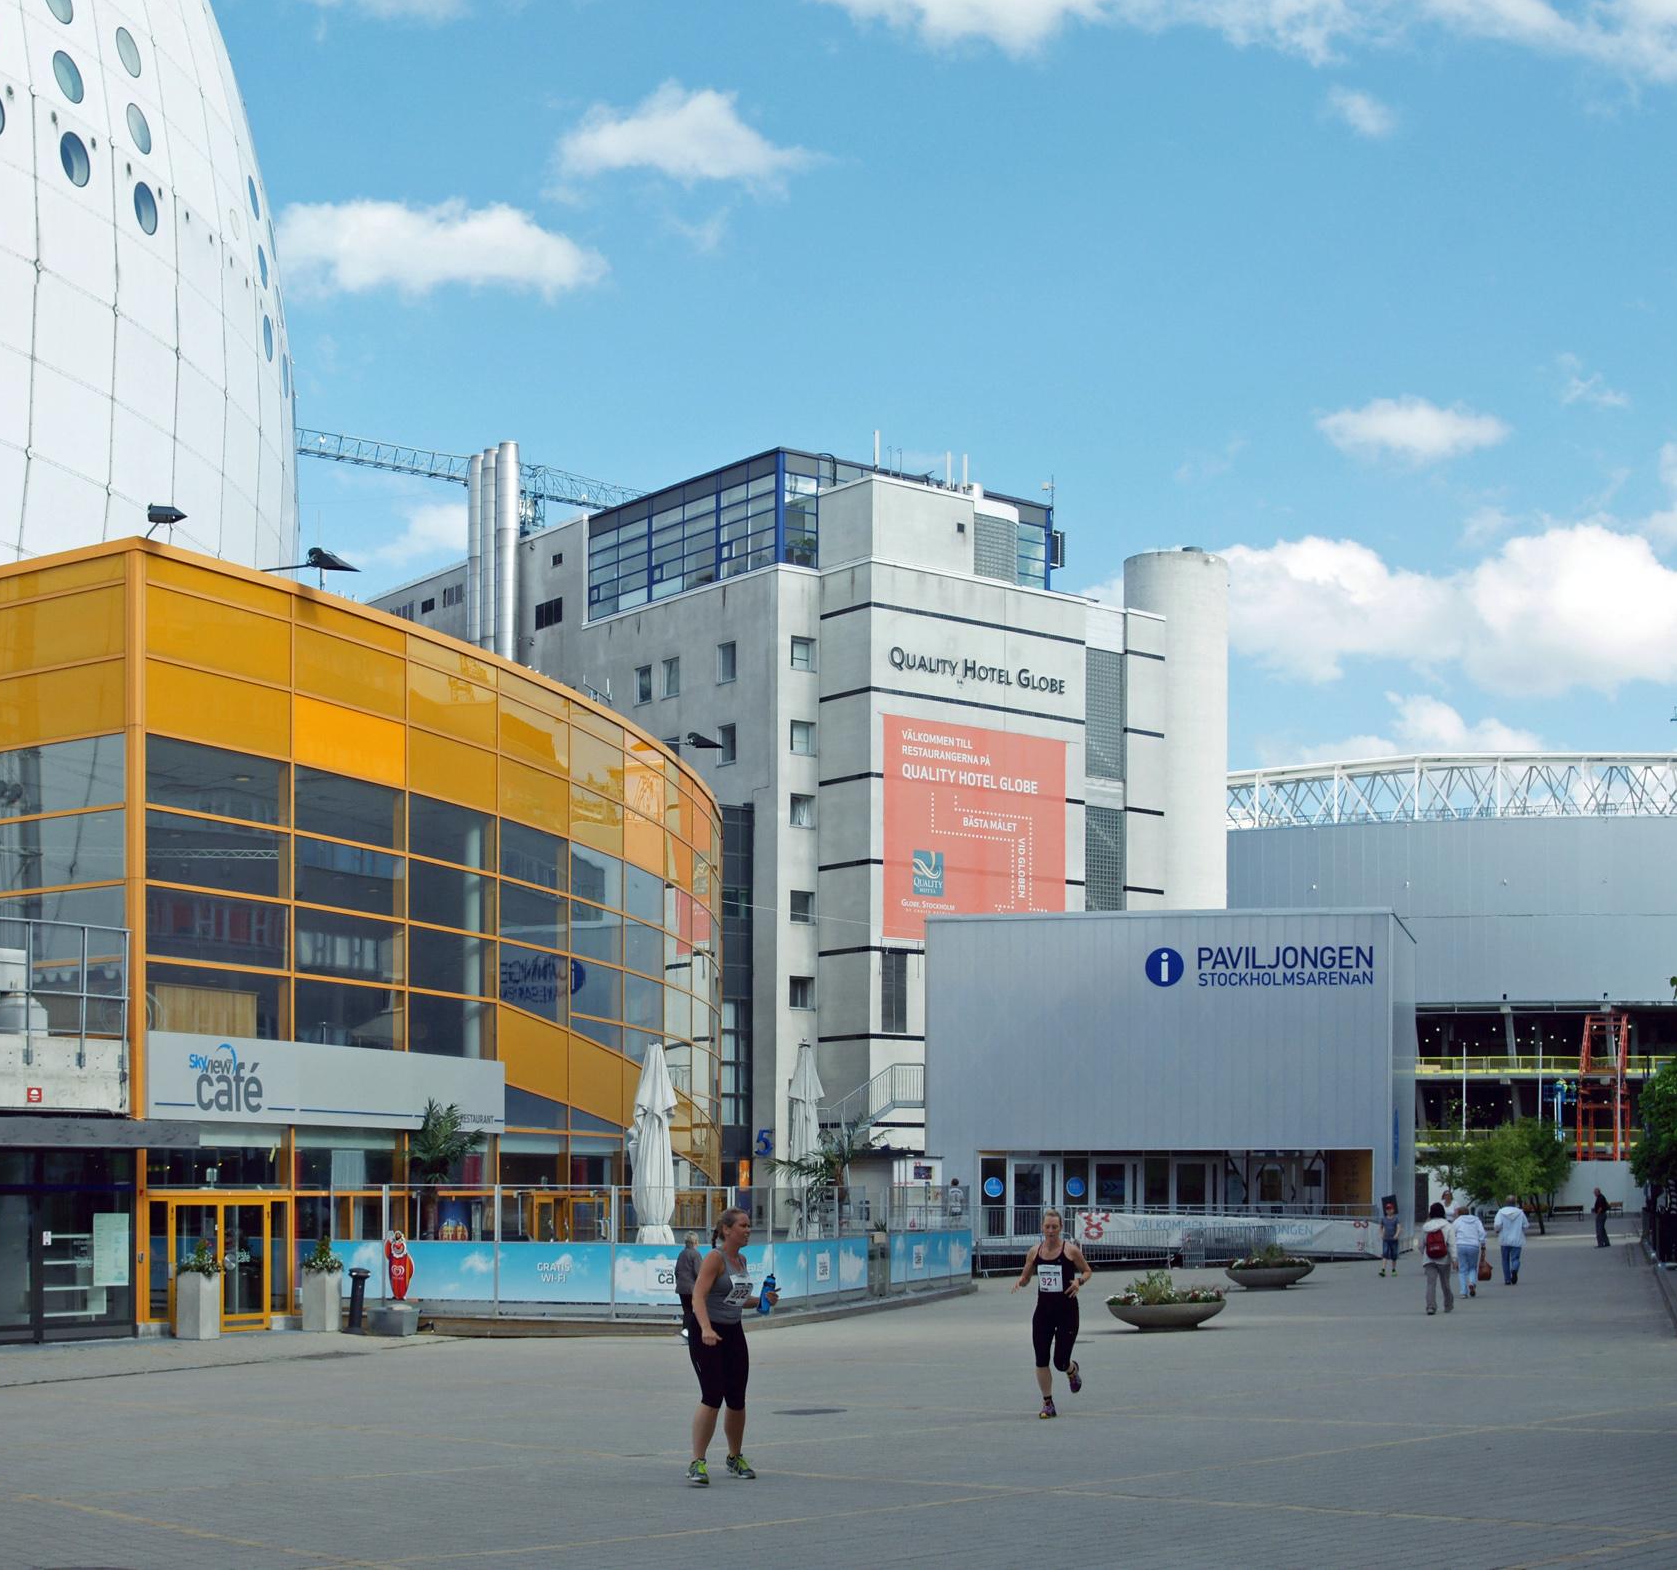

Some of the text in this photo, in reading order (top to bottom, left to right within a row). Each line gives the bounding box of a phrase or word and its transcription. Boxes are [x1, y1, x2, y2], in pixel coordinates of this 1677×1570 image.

[962, 658, 1013, 686] HOTEL
[1015, 668, 1066, 695] GLOBE
[901, 728, 973, 749] VÄLKOMMEN TILL
[902, 745, 991, 767] RESTAURANGERNA PÅ
[902, 762, 1038, 795] QUALITY HOTEL GLOBE
[962, 816, 1018, 832] BÄSTA MÅLET
[1018, 837, 1026, 899] VID GLOBEN
[1197, 946, 1374, 970] PAVILJONGEN
[1198, 971, 1374, 987] STOCKHOLMSARENAN
[196, 1061, 263, 1113] café
[754, 1129, 773, 1156] 5
[537, 1262, 571, 1272] GRATIS
[1041, 1277, 1057, 1286] 921
